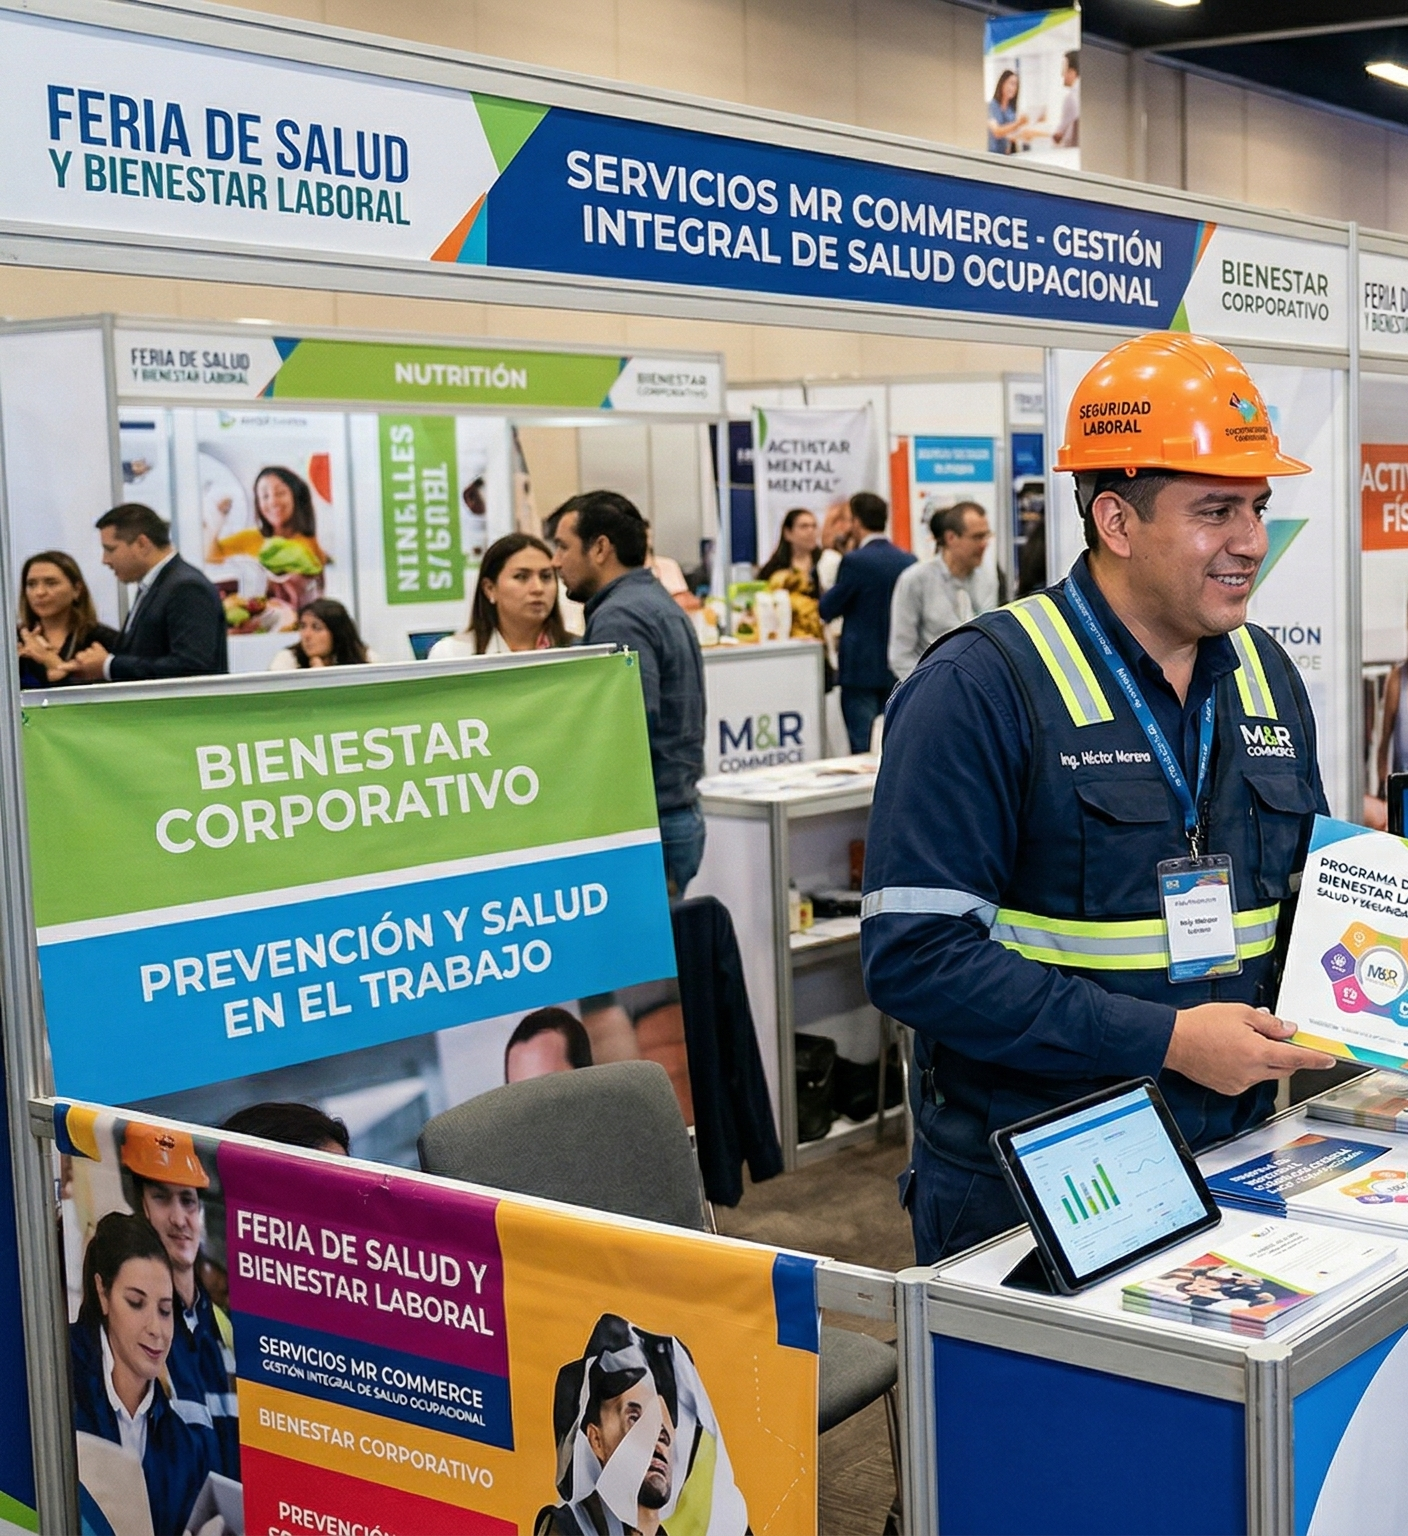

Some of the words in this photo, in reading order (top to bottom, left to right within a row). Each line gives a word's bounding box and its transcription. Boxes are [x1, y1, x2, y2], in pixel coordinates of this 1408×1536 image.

[47, 84, 190, 157] FERIA
[206, 107, 262, 166] DE
[275, 118, 409, 184] SALUD
[48, 149, 71, 188] Y
[84, 153, 268, 211] BIENESTAR
[277, 178, 410, 225] LABORAL
[567, 150, 778, 214] SERVICIOS
[790, 184, 842, 224] MR
[852, 194, 1028, 250] COMMERCE
[1053, 225, 1161, 269] GESTIÓN
[583, 205, 781, 264] INTEGRAL
[792, 231, 838, 270] DE
[848, 239, 955, 283] SALUD
[963, 254, 1158, 307] OCUPACIONAL
[1222, 259, 1328, 297] BIENESTAR
[1222, 291, 1329, 321] CORPORATIVO
[131, 348, 175, 366] FERIA
[180, 350, 197, 367] DE
[202, 351, 250, 370] SALUD
[1079, 400, 1151, 420] SEGURIDAD
[1083, 418, 1142, 436] LABORAL
[1267, 621, 1321, 645] TIÓN
[196, 717, 492, 791] BIENESTAR
[719, 711, 803, 755] M&R
[1240, 725, 1293, 747] M&R
[1060, 752, 1080, 770] Ing.
[155, 765, 539, 854] CORPORATIVO
[1319, 872, 1393, 902] BIENESTAR
[1320, 857, 1397, 887] PROGRAMA
[139, 910, 435, 1002] PREVENCIÓN
[443, 906, 470, 943] Y
[482, 882, 609, 936] SALUD
[223, 998, 284, 1040] EN
[299, 980, 353, 1023] EL
[360, 938, 553, 1005] TRABAJO
[237, 1210, 315, 1256] FERIA
[321, 1228, 358, 1265] DE
[365, 1239, 461, 1288] SALUD
[468, 1261, 488, 1294] Y
[238, 1251, 369, 1306] BIENESTAR
[375, 1283, 494, 1336] LABORAL
[259, 1335, 347, 1373] SERVICIOS
[350, 1358, 377, 1381] MR
[382, 1366, 483, 1409] COMMERCE
[357, 1383, 372, 1397] DE
[373, 1388, 408, 1406] SALUD
[259, 1408, 355, 1451] BIENESTAR
[359, 1436, 493, 1489] CORPORATIVO
[279, 1501, 396, 1536] PREVENCI
